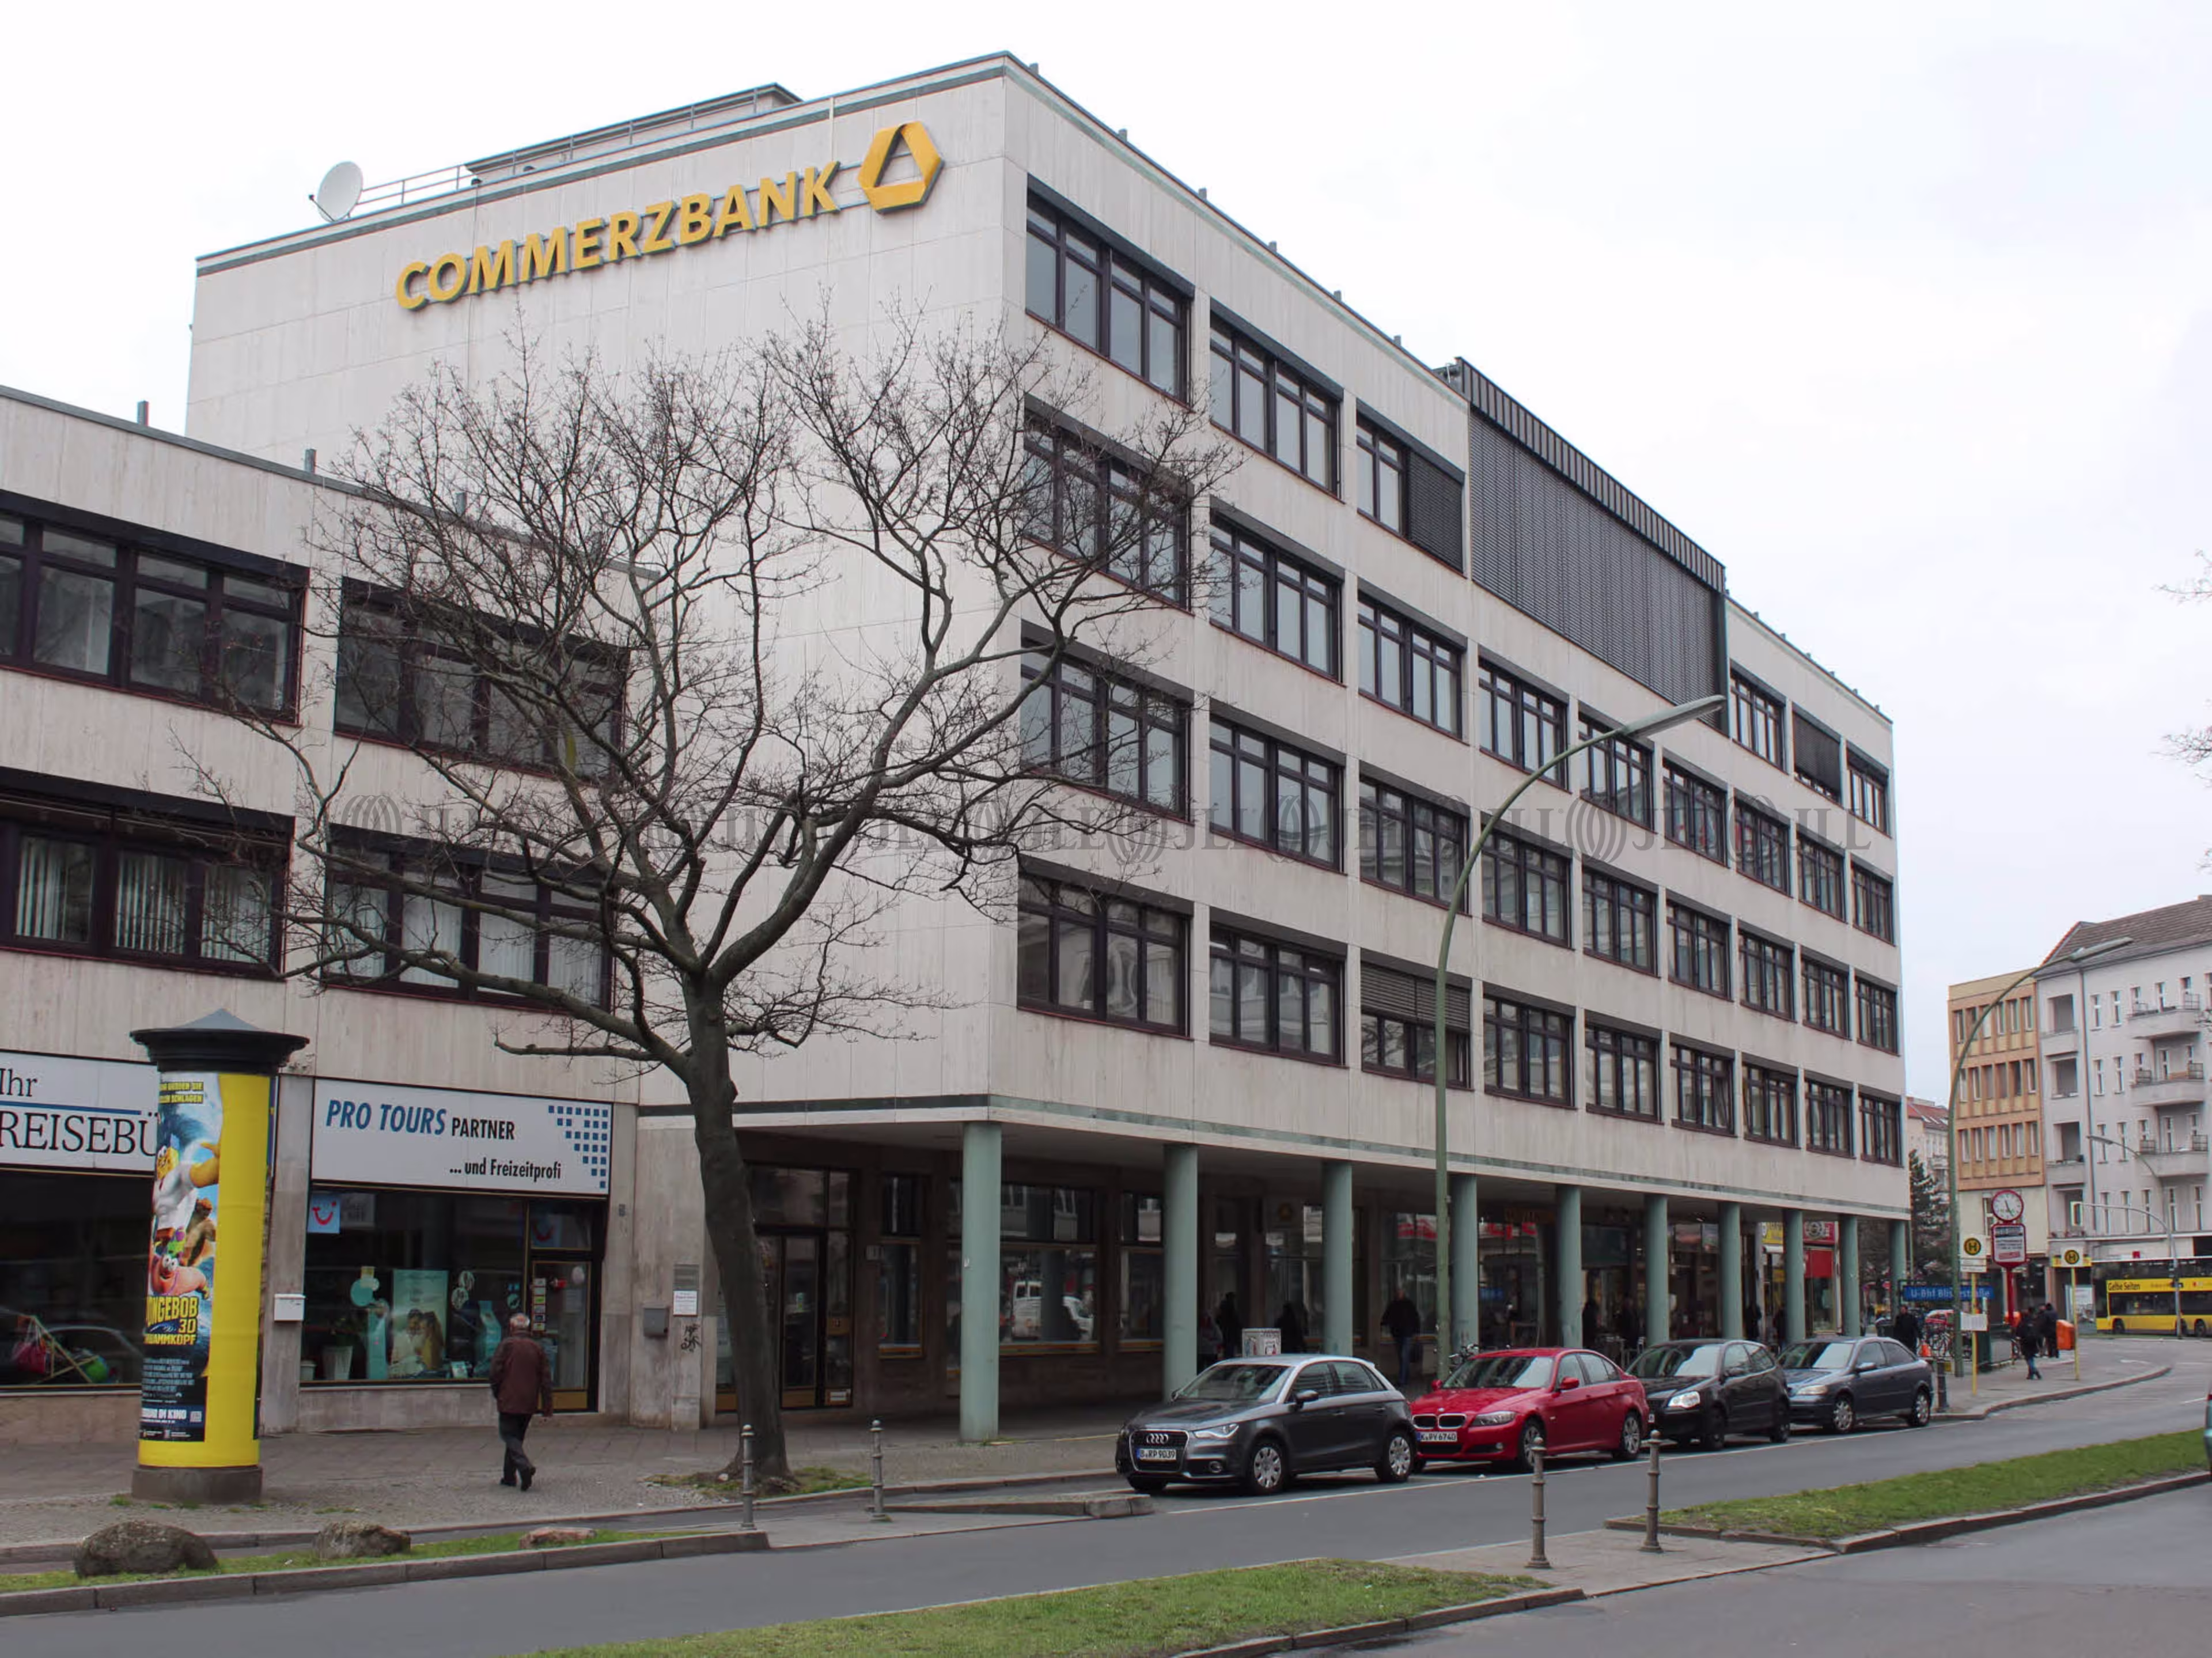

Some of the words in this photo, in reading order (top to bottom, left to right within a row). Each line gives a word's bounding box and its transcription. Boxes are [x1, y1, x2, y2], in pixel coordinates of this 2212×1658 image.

[395, 161, 840, 310] COMMERZBANK
[0, 1068, 37, 1097] Ihr
[326, 1099, 372, 1130] PRO
[380, 1104, 446, 1135] TOURS
[452, 1117, 515, 1140] PARTNER
[465, 1157, 487, 1176] und
[491, 1159, 562, 1183] Freizeitprofi
[1910, 1287, 1936, 1297] U-Bhf
[2108, 1282, 2123, 1291] Gelbe
[2123, 1281, 2141, 1290] Seiten
[179, 1318, 196, 1334] 3D
